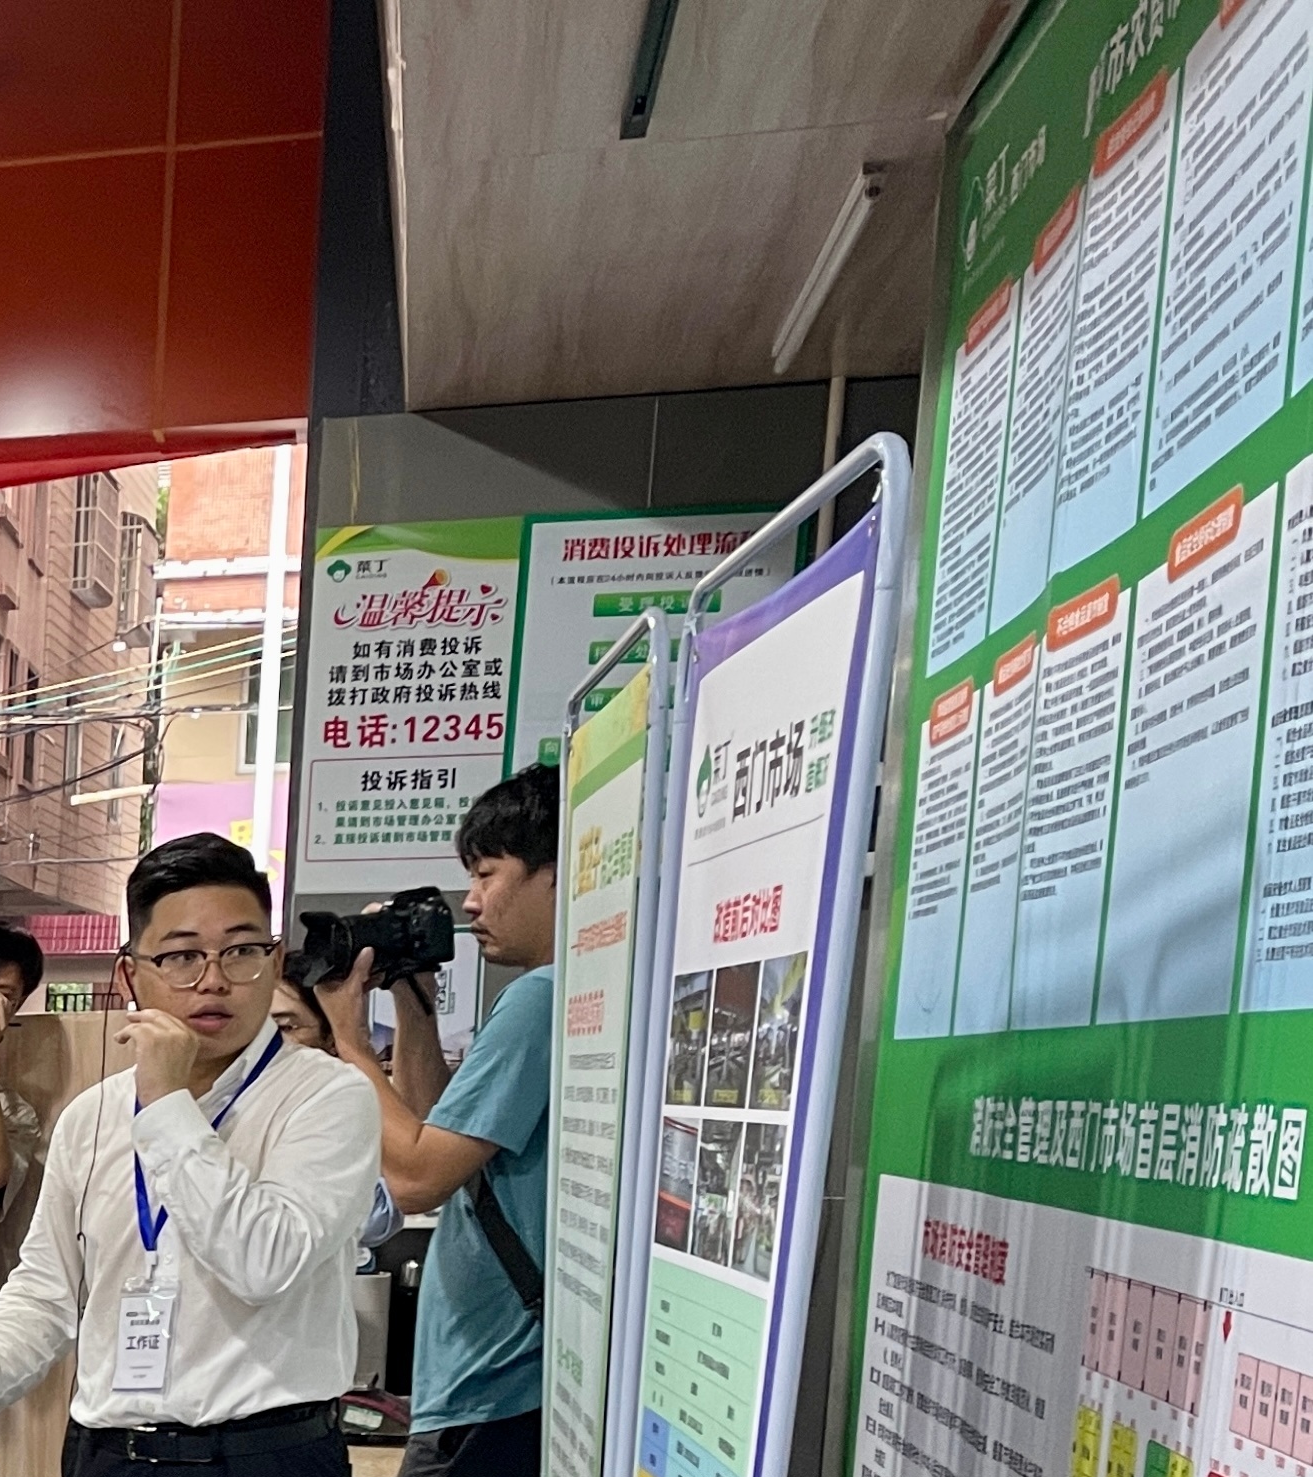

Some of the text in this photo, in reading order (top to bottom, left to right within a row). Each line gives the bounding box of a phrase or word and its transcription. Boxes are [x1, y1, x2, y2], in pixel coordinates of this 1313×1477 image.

[334, 586, 507, 629] 温馨提示
[352, 636, 482, 660] 如有消费投诉
[328, 658, 503, 684] 请到市场办公室或
[327, 680, 502, 707] 拨打政府投诉热线
[323, 712, 505, 749] 电话:12345
[360, 767, 457, 792] 投诉指引
[731, 719, 806, 823] 西门市场
[970, 1096, 1307, 1201] 消防安全管理及西门市场首层消防疏散图
[125, 1334, 161, 1350] 工作证
